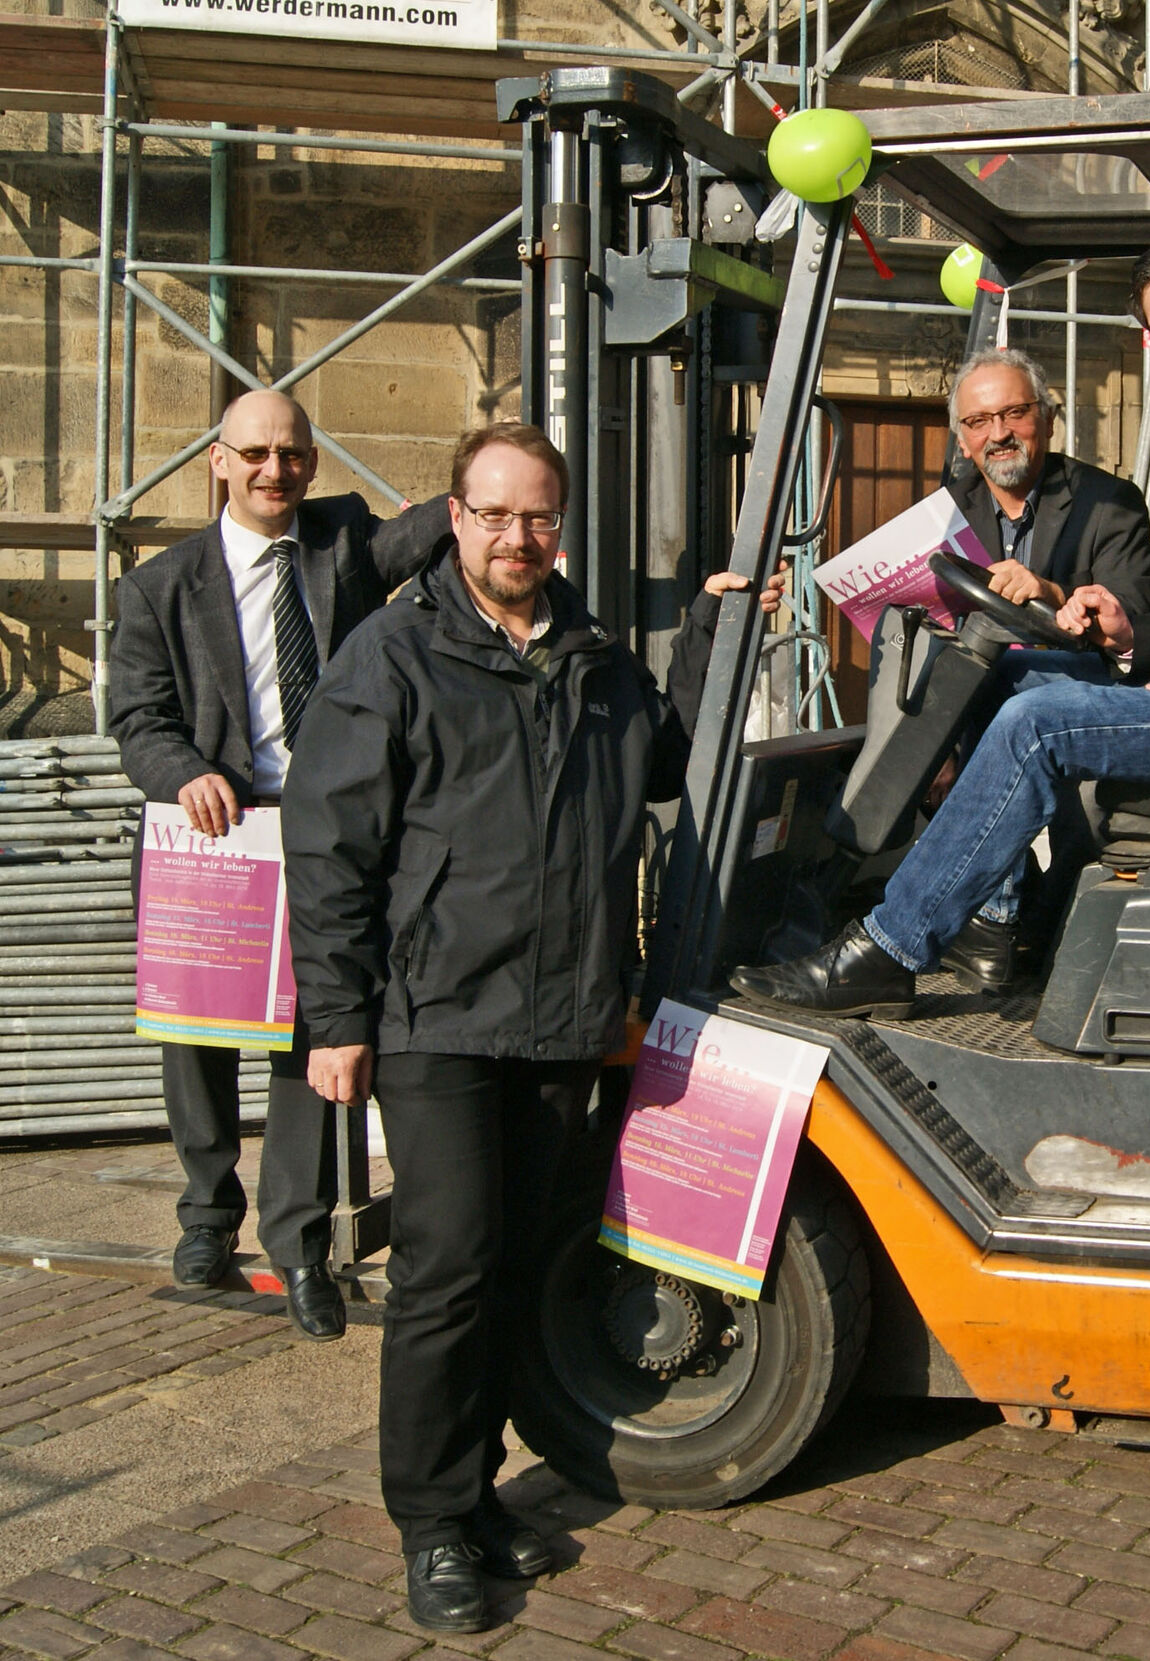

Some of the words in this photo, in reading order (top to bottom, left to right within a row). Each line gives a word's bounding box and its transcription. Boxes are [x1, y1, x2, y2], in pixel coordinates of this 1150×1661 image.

[550, 283, 566, 453] STILL
[826, 554, 919, 600] Wie...
[858, 587, 887, 604] wollen
[888, 576, 904, 589] wir
[150, 822, 247, 858] Wie...
[164, 856, 197, 866] wollen
[201, 859, 220, 869] wir
[222, 861, 257, 872] leben?
[699, 1067, 719, 1083] wir
